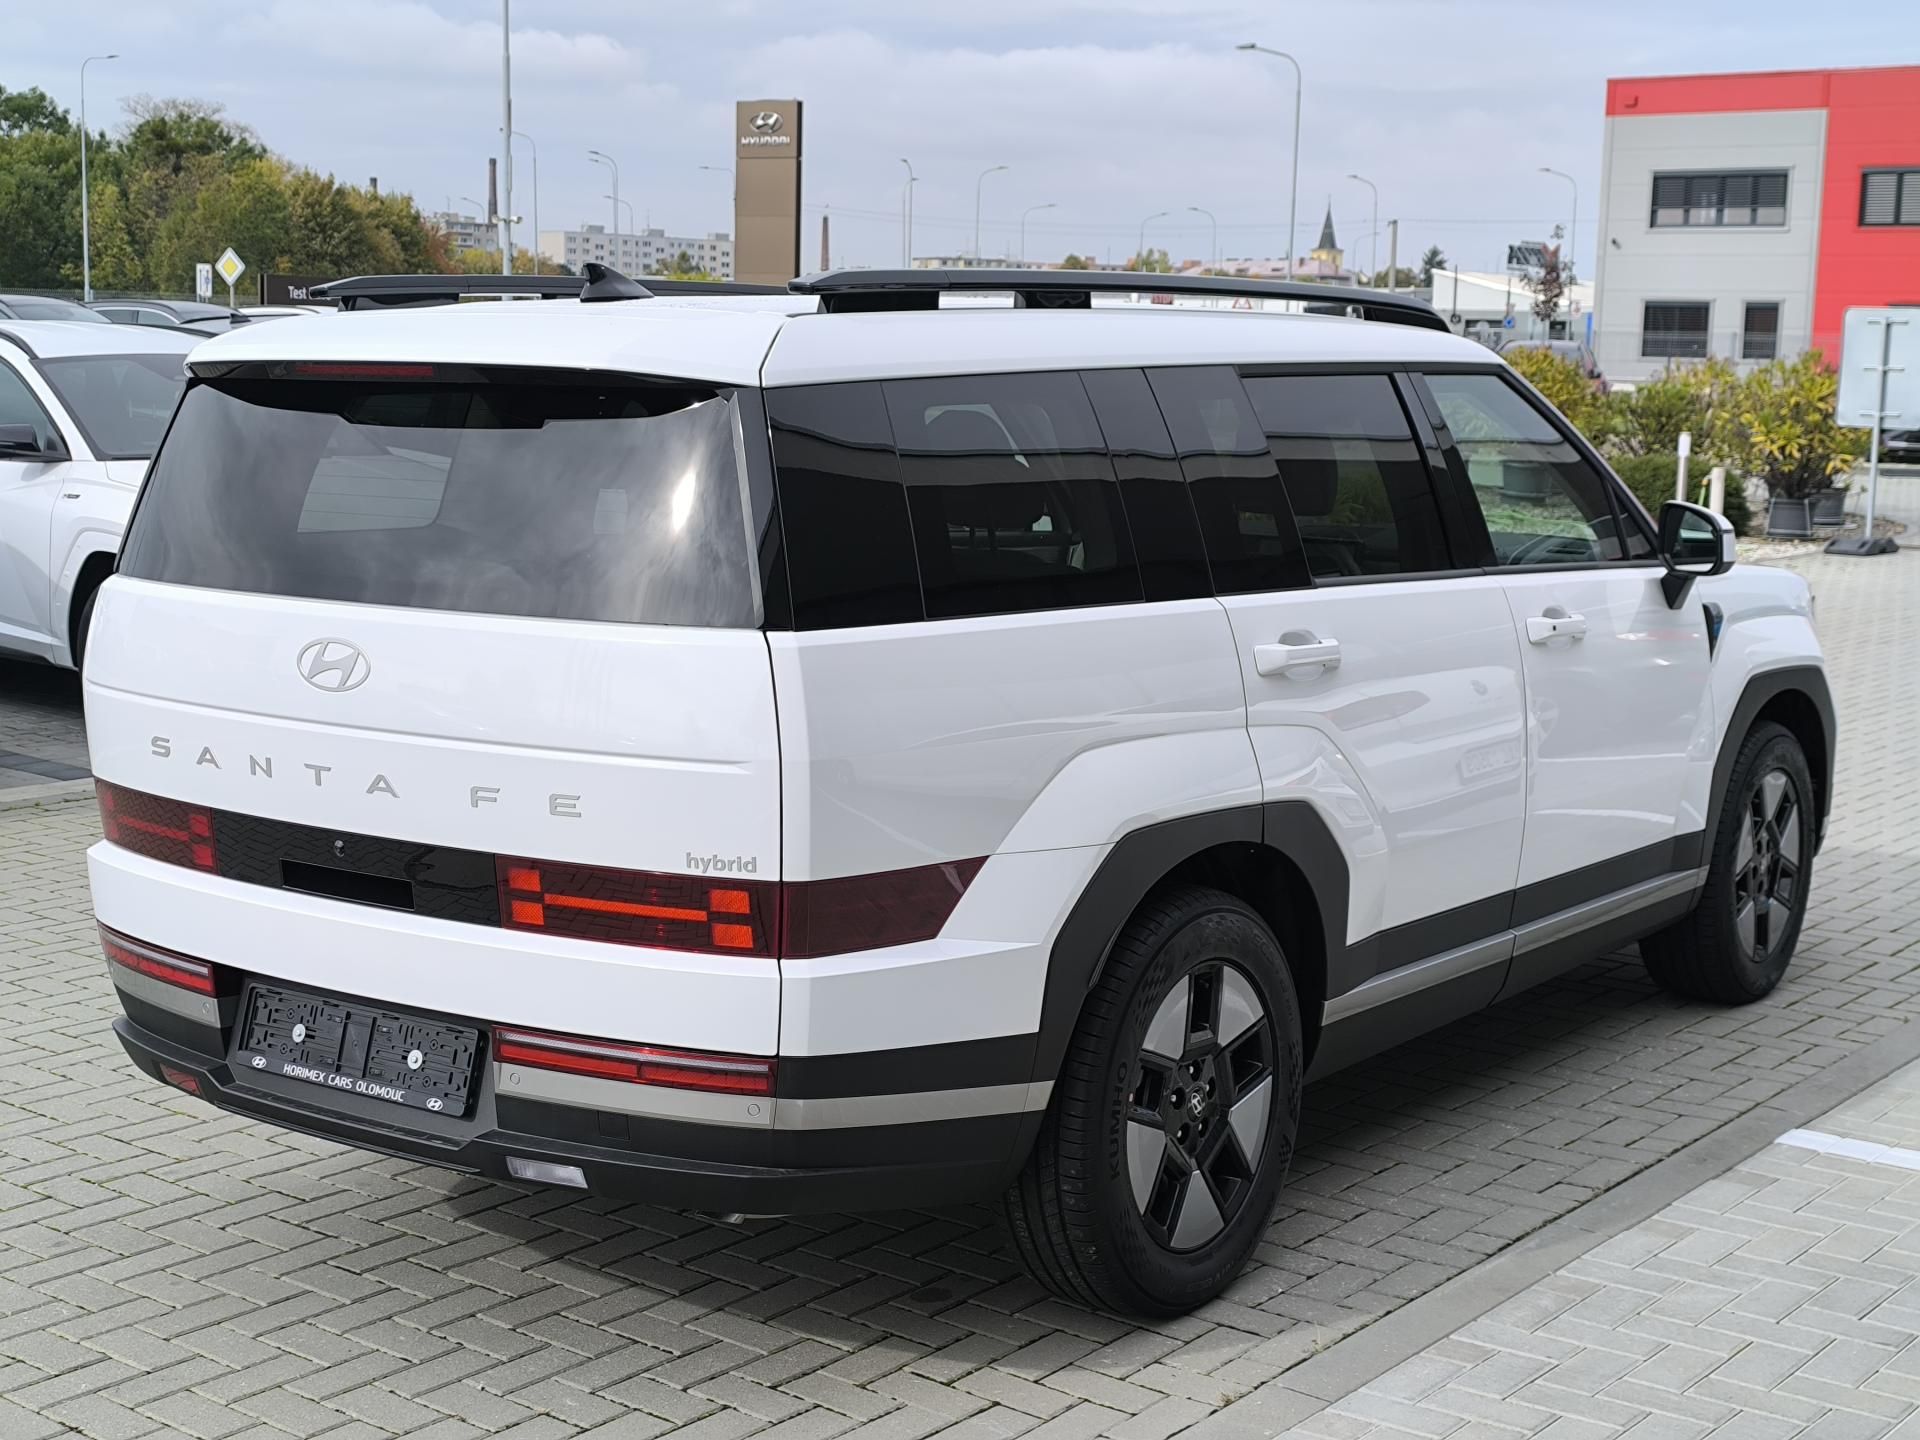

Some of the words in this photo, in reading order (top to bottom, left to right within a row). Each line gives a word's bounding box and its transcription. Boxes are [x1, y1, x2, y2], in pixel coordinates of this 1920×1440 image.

[741, 136, 790, 145] HYUNDAI
[288, 286, 307, 299] Test
[150, 735, 400, 800] SANTA
[470, 785, 582, 818] FE
[686, 852, 757, 873] hybrid
[283, 1063, 326, 1083] HORIMEX
[327, 1074, 354, 1089] CARS
[355, 1081, 406, 1102] OLOMOUC
[1110, 1062, 1128, 1180] KUMHO
